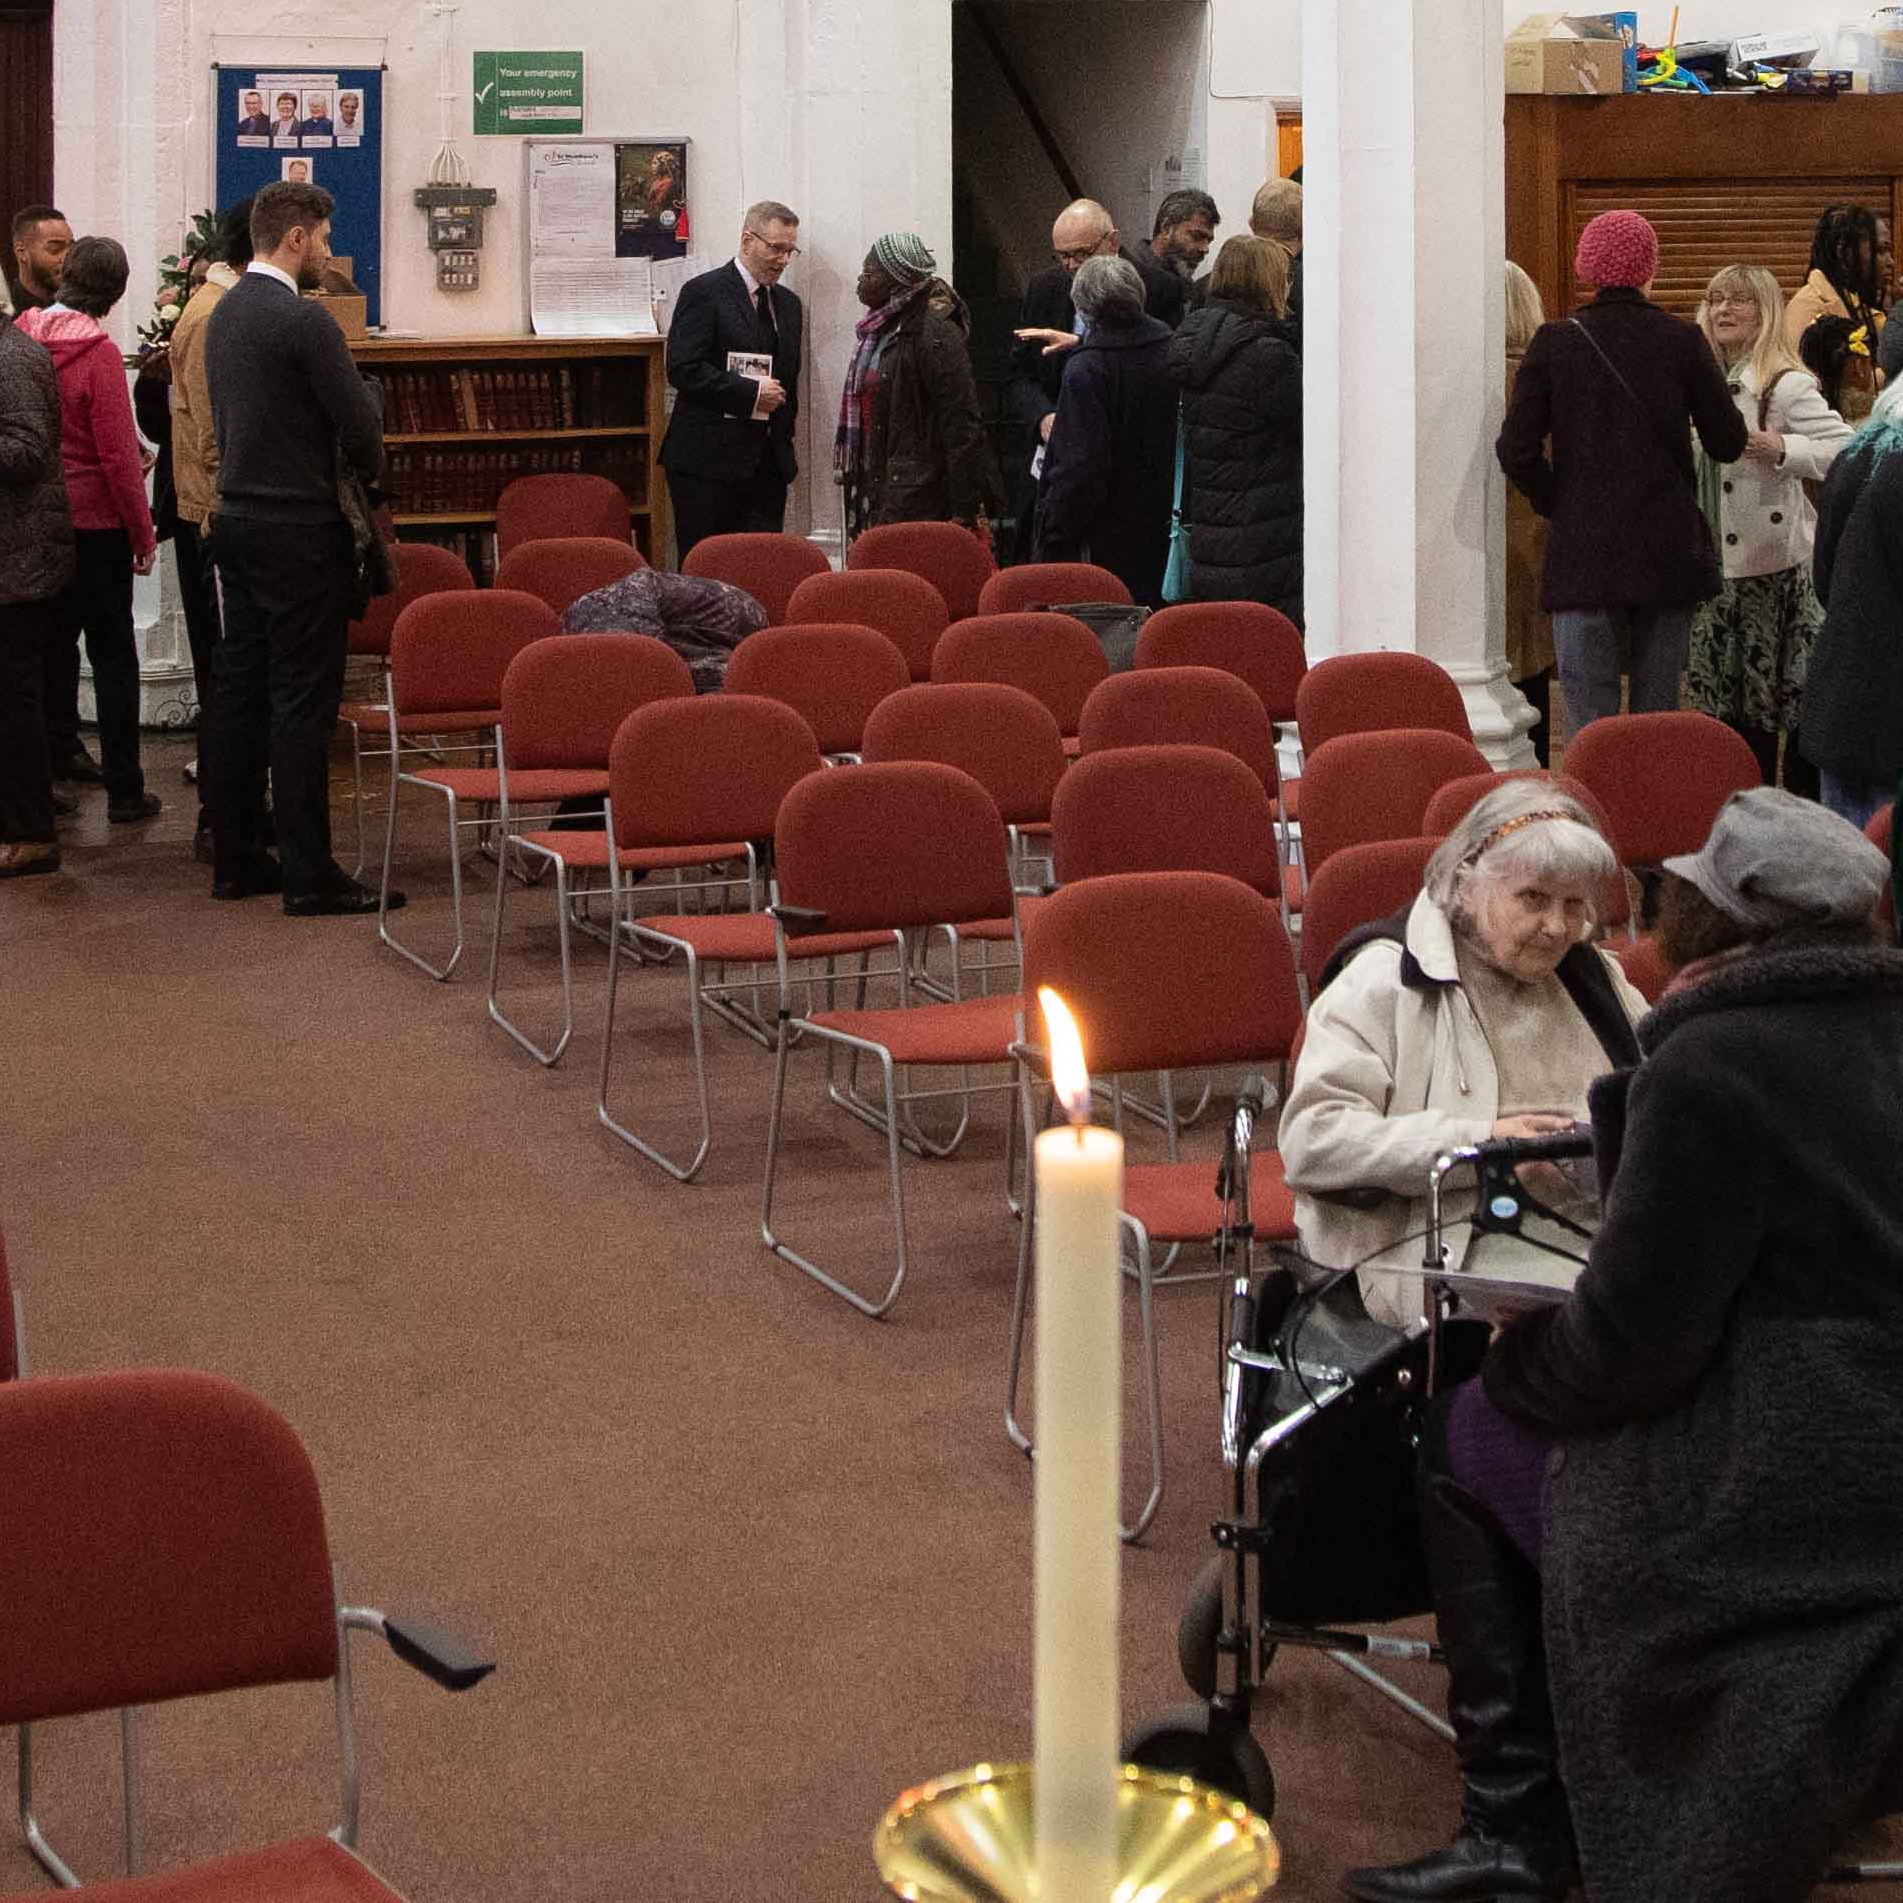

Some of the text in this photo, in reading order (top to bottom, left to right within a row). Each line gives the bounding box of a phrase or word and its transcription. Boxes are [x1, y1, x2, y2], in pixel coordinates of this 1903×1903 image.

[500, 68, 577, 79] Your emergency
[500, 89, 572, 98] assembly point
